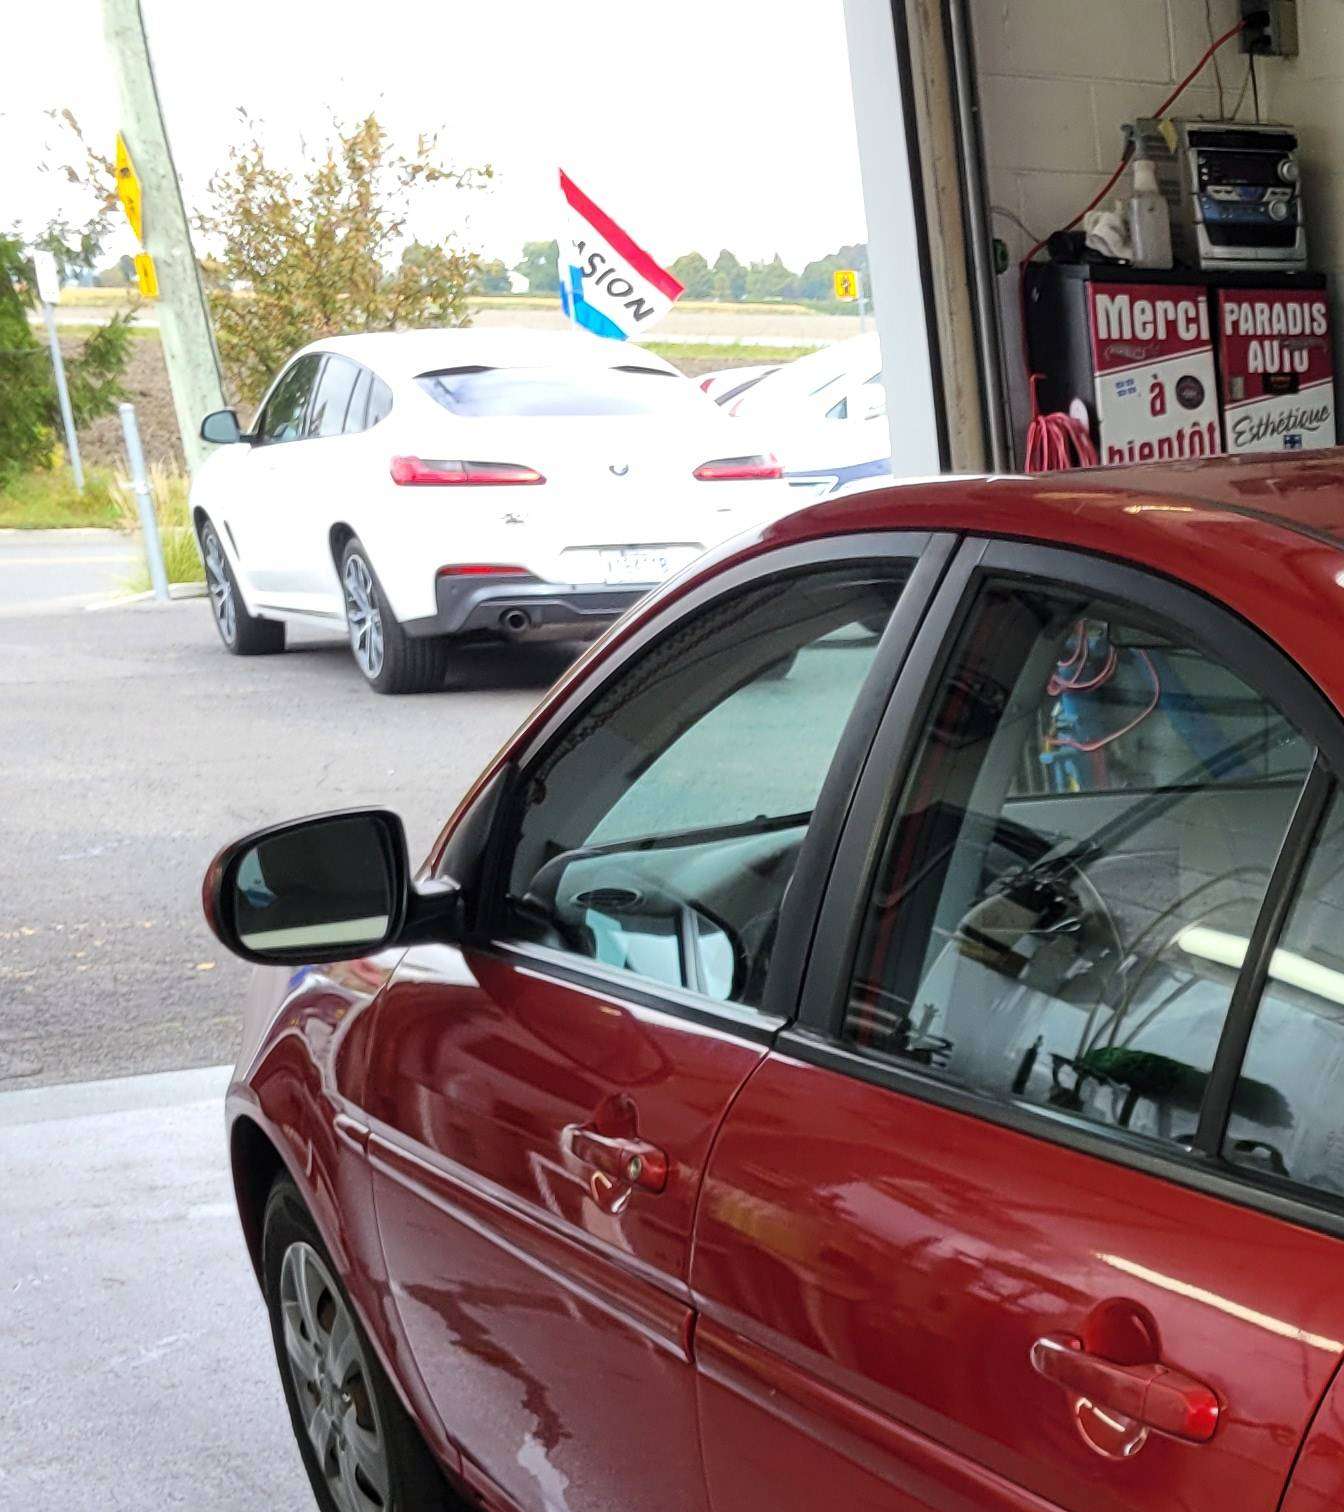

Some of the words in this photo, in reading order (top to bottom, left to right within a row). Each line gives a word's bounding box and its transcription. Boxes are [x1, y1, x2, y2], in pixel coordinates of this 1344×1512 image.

[1095, 293, 1211, 341] Merci
[1223, 302, 1328, 336] PARADIS
[1149, 373, 1167, 417] à
[1232, 405, 1331, 448] Esthétique
